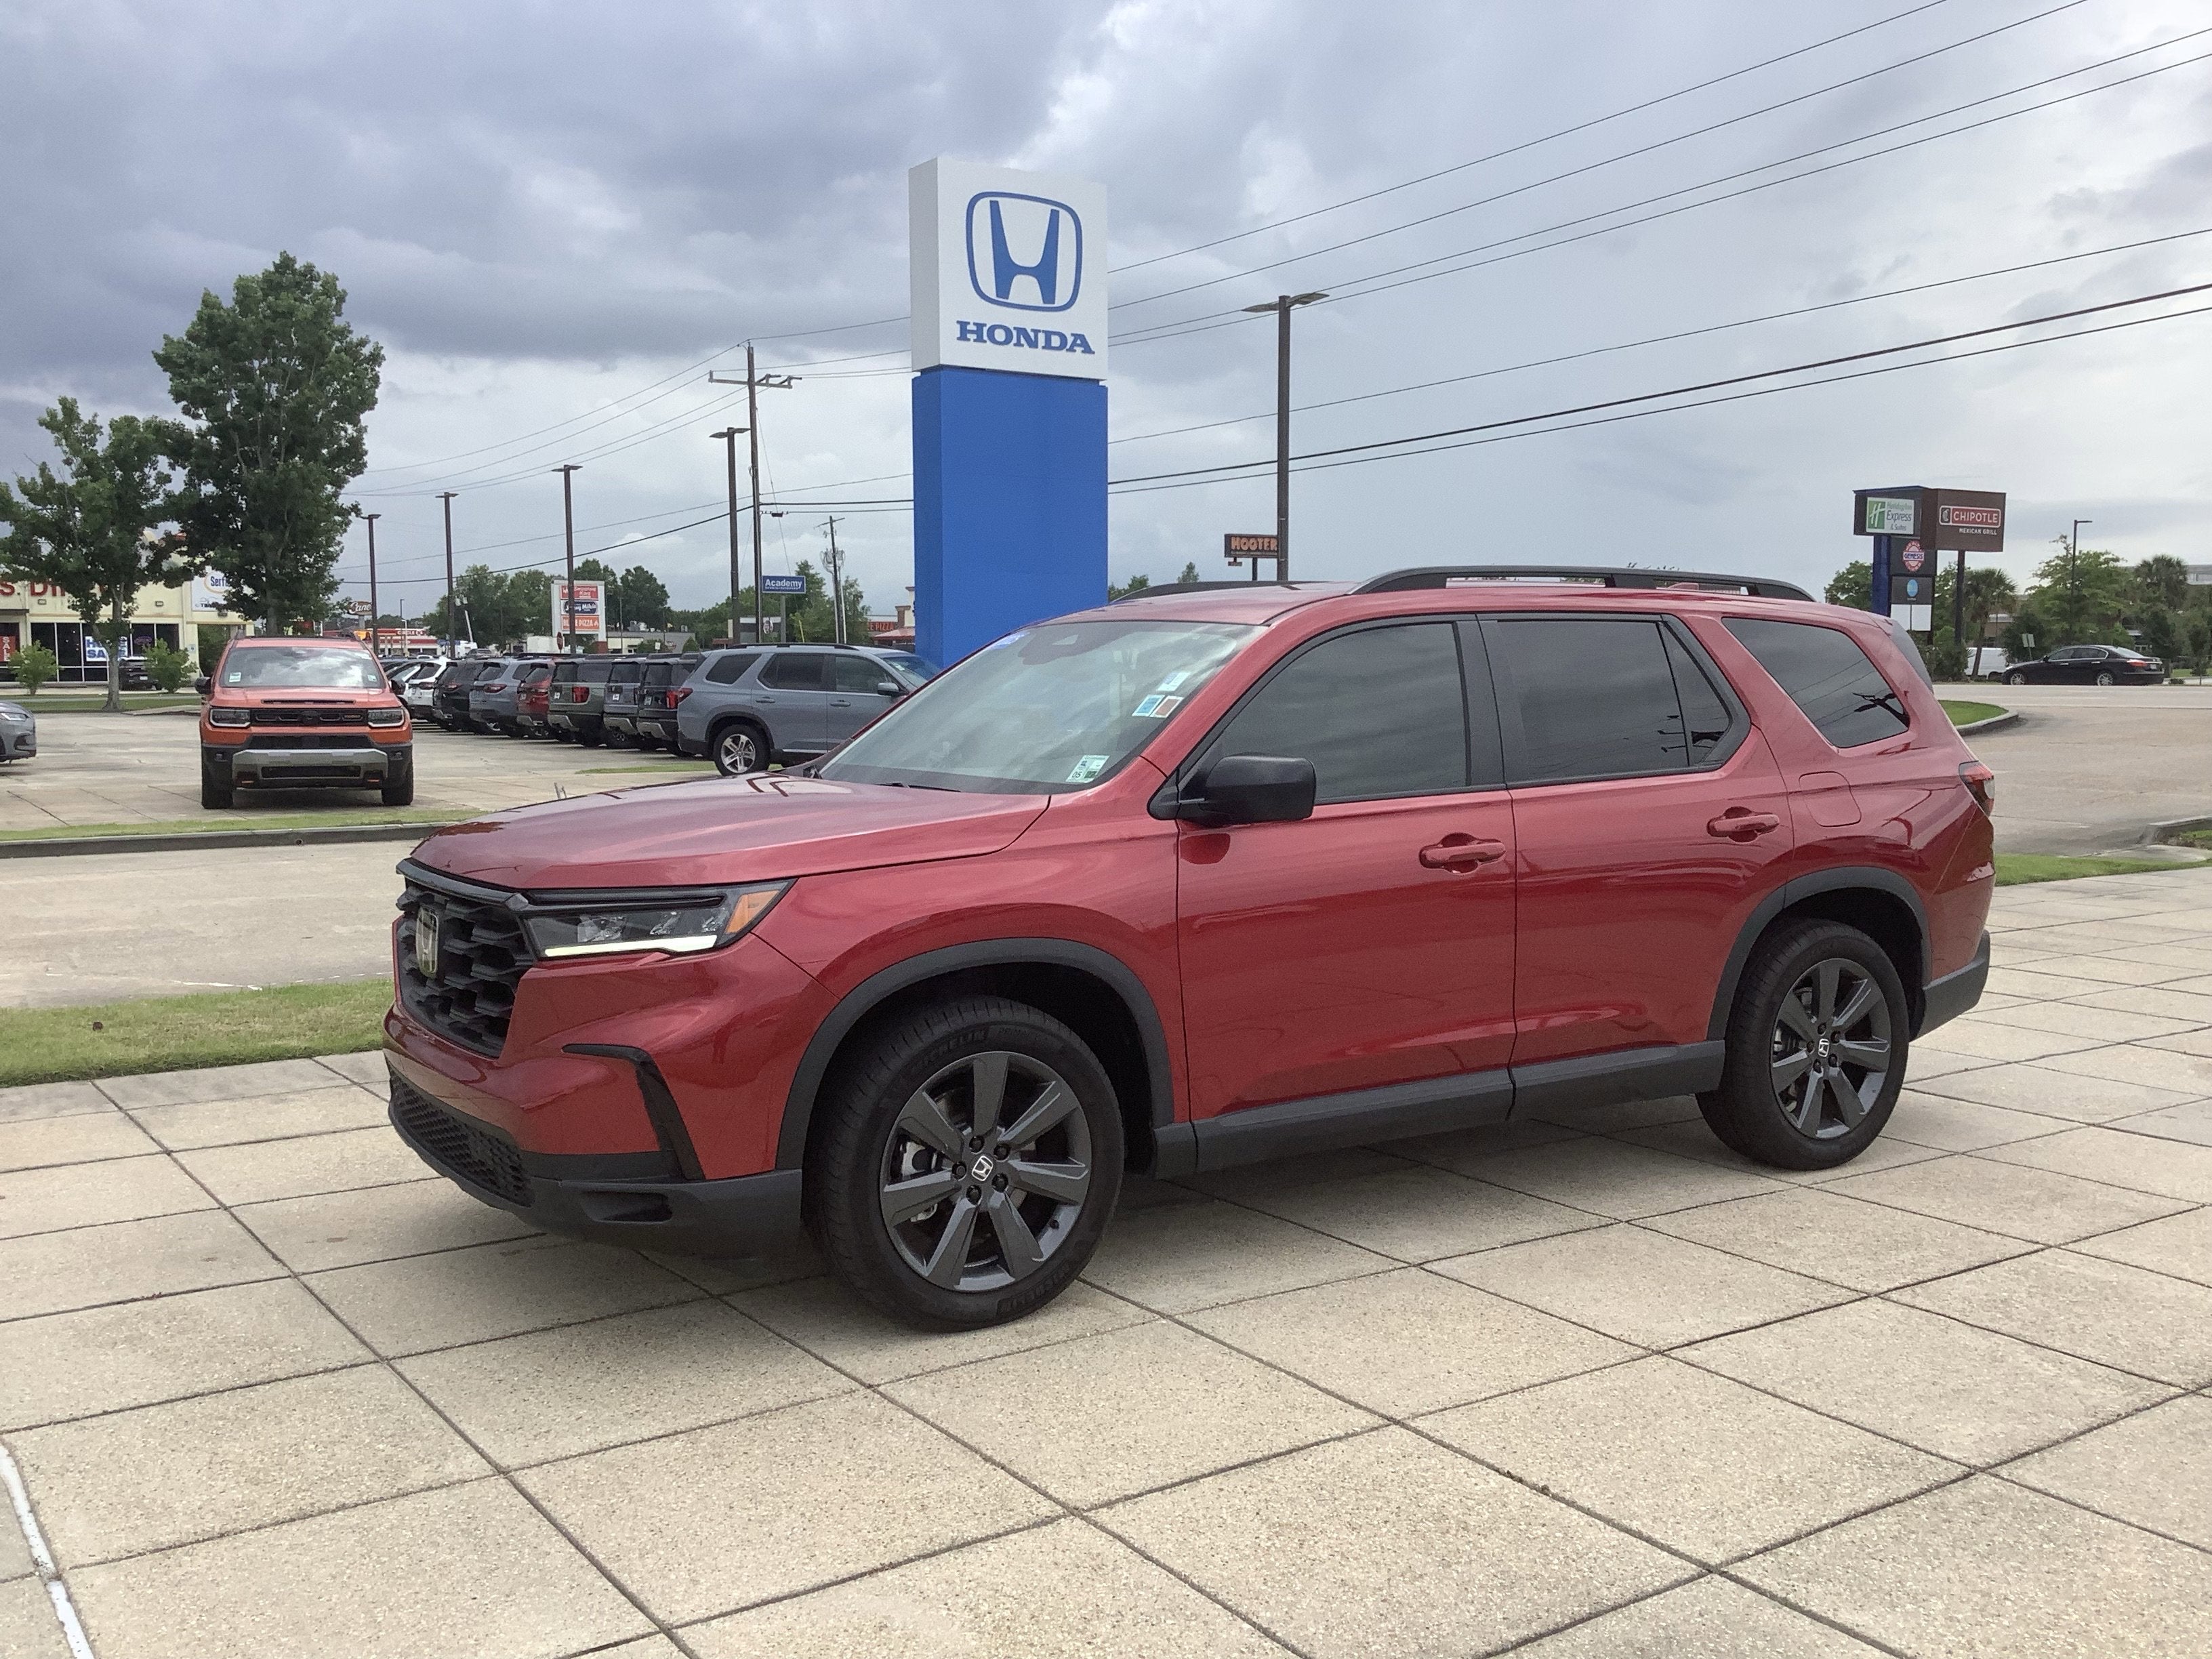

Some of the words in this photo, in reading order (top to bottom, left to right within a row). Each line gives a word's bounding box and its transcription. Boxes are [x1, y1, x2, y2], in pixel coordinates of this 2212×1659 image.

[956, 320, 1095, 355] HONDA
[1886, 510, 1912, 523] Express
[1953, 511, 1998, 523] CHIPOTLE
[765, 579, 802, 589] Academy
[579, 619, 594, 627] PIZZA
[875, 622, 894, 631] PIZZA
[87, 649, 126, 658] SAE
